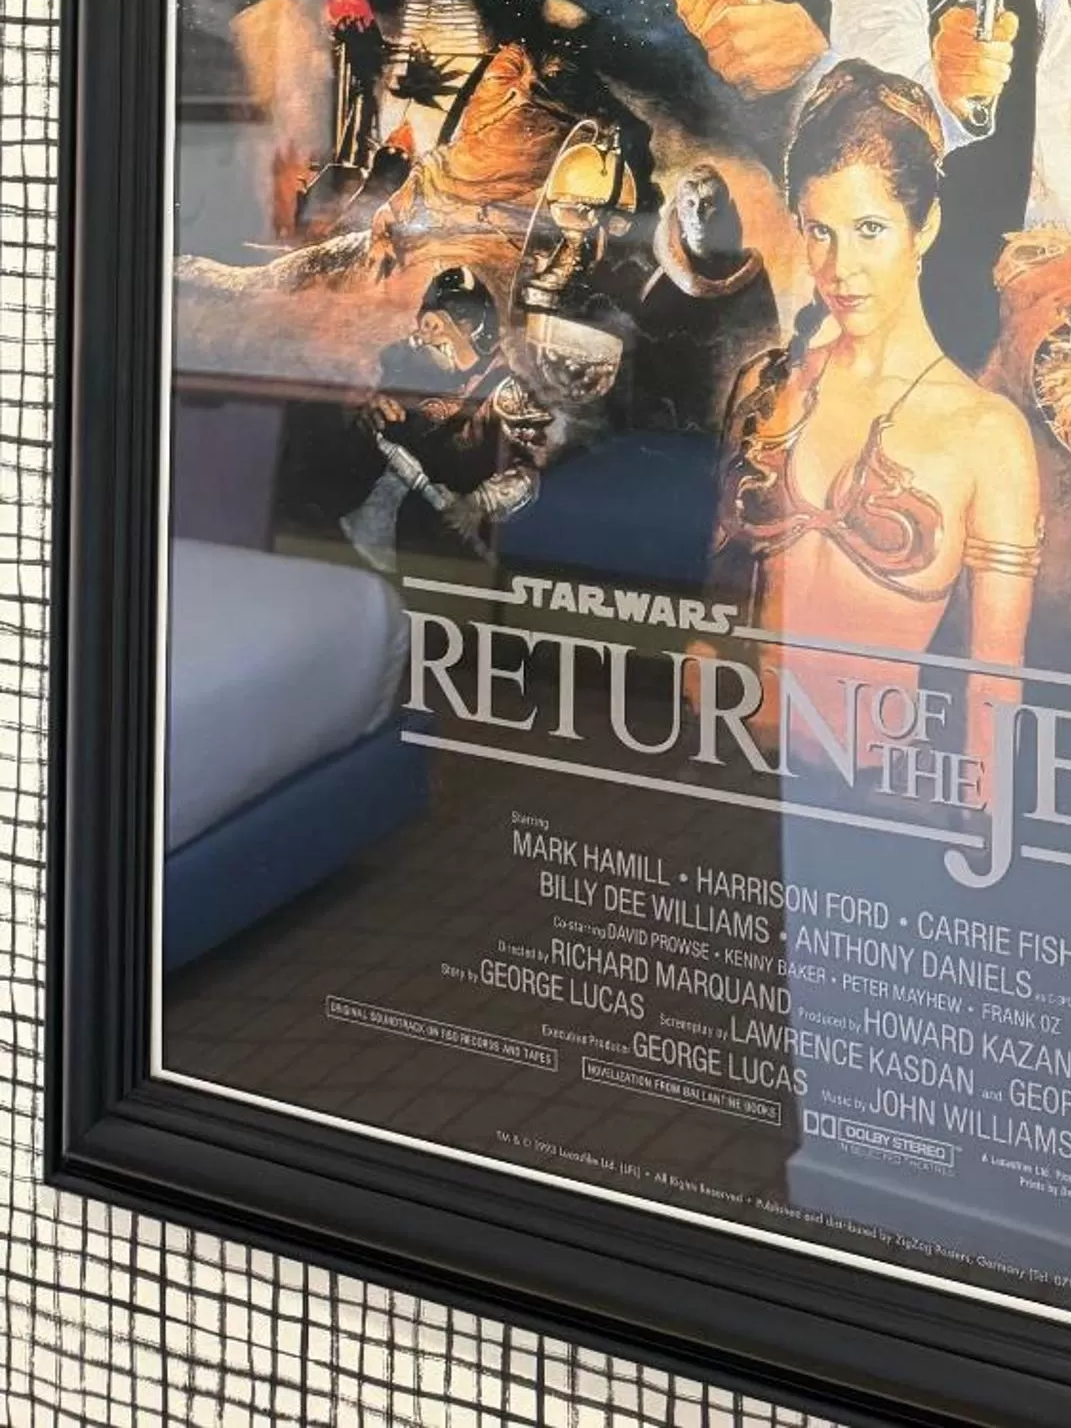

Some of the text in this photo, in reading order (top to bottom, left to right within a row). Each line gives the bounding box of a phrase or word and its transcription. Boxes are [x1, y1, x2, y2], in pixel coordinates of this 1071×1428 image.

[511, 575, 739, 635] STAR WARS
[402, 609, 872, 789] RETURN
[870, 684, 953, 743] OF
[868, 742, 988, 811] THE
[510, 810, 550, 831] Starring
[512, 829, 578, 868] MARK
[583, 843, 671, 887] HAMILL
[696, 866, 818, 916] HARRISON
[825, 891, 889, 931] FORD
[916, 911, 1012, 956] CARRIE
[539, 871, 598, 907] BILLY
[604, 883, 647, 919] DEE
[652, 894, 770, 944] WILLIAMS
[795, 925, 916, 975] ANTHONY
[922, 950, 1032, 999] DANIELS
[498, 939, 536, 961] Directed
[536, 948, 550, 965] by
[550, 938, 649, 984] RICHARD
[655, 960, 793, 1015] MARQUAND
[798, 1007, 847, 1029] Produced
[848, 1018, 862, 1034] by
[863, 1007, 975, 1056] HOWARD
[552, 915, 1064, 1035] Co-starring DAVID PROWSE KENNY BAKER PETER MAYHEW FRANK OZ
[440, 963, 466, 982] Story
[467, 968, 479, 984] by
[480, 958, 564, 1001] GEORGE
[570, 978, 645, 1020] LUCAS
[659, 1012, 714, 1039] Screenplay
[715, 1025, 729, 1041] by
[730, 1015, 864, 1070] LAWRENCE
[869, 1046, 974, 1096] KASDAN
[981, 1087, 1003, 1102] and
[524, 1047, 552, 1065] TAPES
[541, 1023, 588, 1046] Executive
[632, 1031, 722, 1077] GEORGE
[728, 1051, 809, 1097] LUCAS
[821, 1089, 852, 1108] Music
[853, 1097, 867, 1113] by
[869, 1087, 936, 1126] JOHN
[587, 1063, 652, 1089] NOVELIZATION
[653, 1079, 681, 1096] FROM
[845, 1126, 946, 1160] DOLBY STEREO
